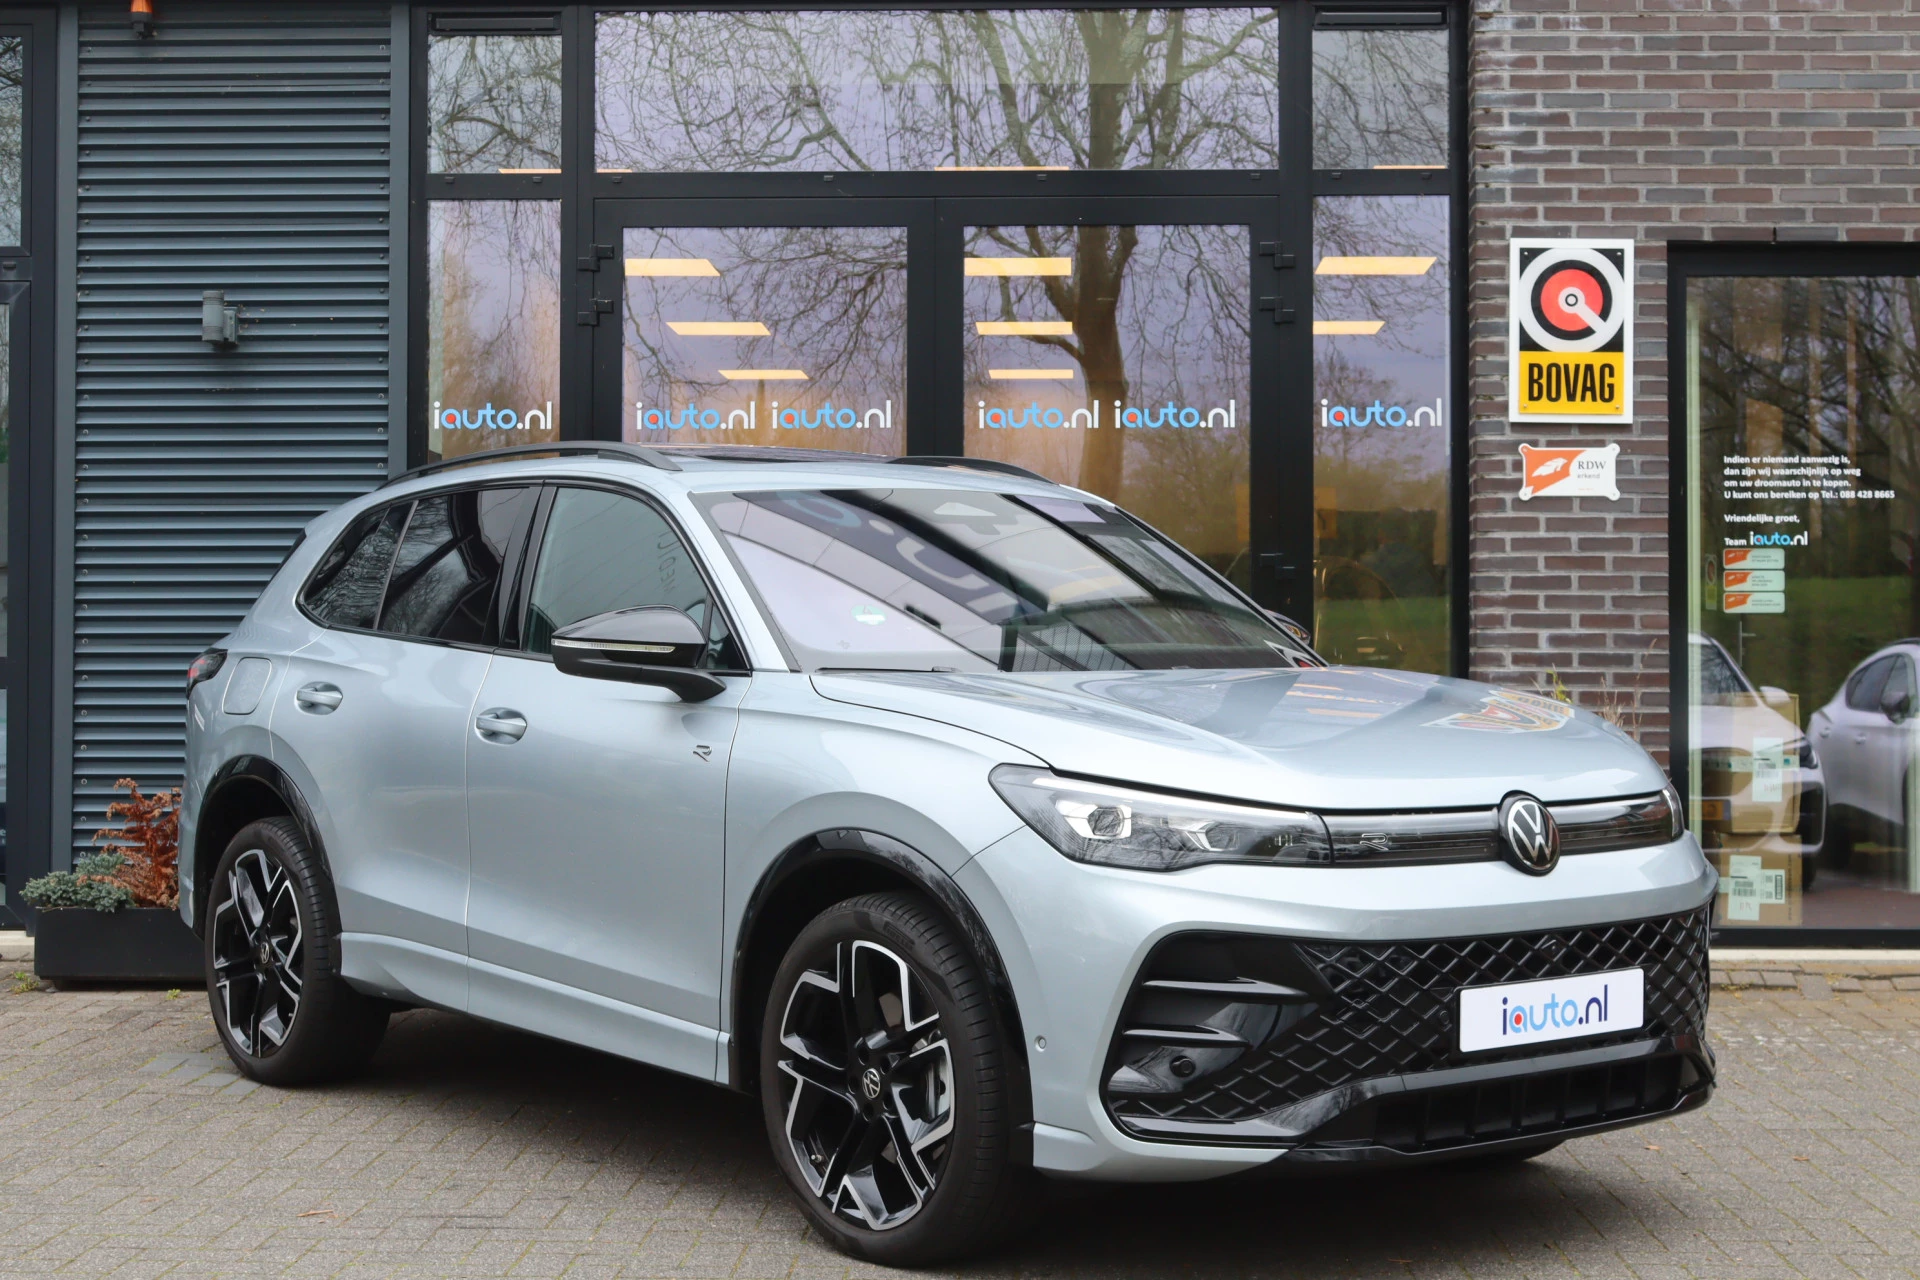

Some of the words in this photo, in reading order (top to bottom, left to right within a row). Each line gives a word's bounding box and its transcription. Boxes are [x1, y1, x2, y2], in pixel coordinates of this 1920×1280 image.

[1528, 363, 1614, 403] BOVAG
[433, 401, 552, 430] iauto.nl
[635, 401, 756, 430] iauto.nl
[771, 400, 892, 429] iauto.nl
[978, 400, 1099, 429] iauto.nl
[1114, 400, 1235, 429] iauto.nl
[1321, 397, 1442, 427] iauto.nl
[1577, 460, 1607, 470] RDW
[1723, 455, 1750, 464] Indien
[1762, 455, 1800, 464] niemand
[1801, 455, 1840, 466] aanwezig
[1841, 455, 1851, 465] is,
[1723, 467, 1740, 476] dan
[1741, 467, 1756, 477] zijn
[1758, 467, 1771, 477] wij
[1772, 466, 1829, 477] waarschijnlijk
[1830, 468, 1842, 477] op
[1843, 468, 1862, 477] weg
[1754, 478, 1801, 487] droomauto
[1802, 478, 1811, 487] in
[1813, 479, 1821, 487] te
[1822, 478, 1852, 489] kopen.
[1723, 490, 1731, 499] U
[1732, 490, 1752, 499] kunt
[1770, 490, 1806, 499] bereiken
[1808, 492, 1820, 500] op
[1839, 490, 1856, 499] 088
[1856, 490, 1873, 499] 428
[1874, 490, 1896, 499] 8665
[1723, 513, 1774, 524] Vriendelijke
[1775, 514, 1801, 524] groet,
[1724, 537, 1747, 546] Team
[1749, 530, 1809, 546] iauto.nl
[1502, 984, 1609, 1035] iauto.nl
